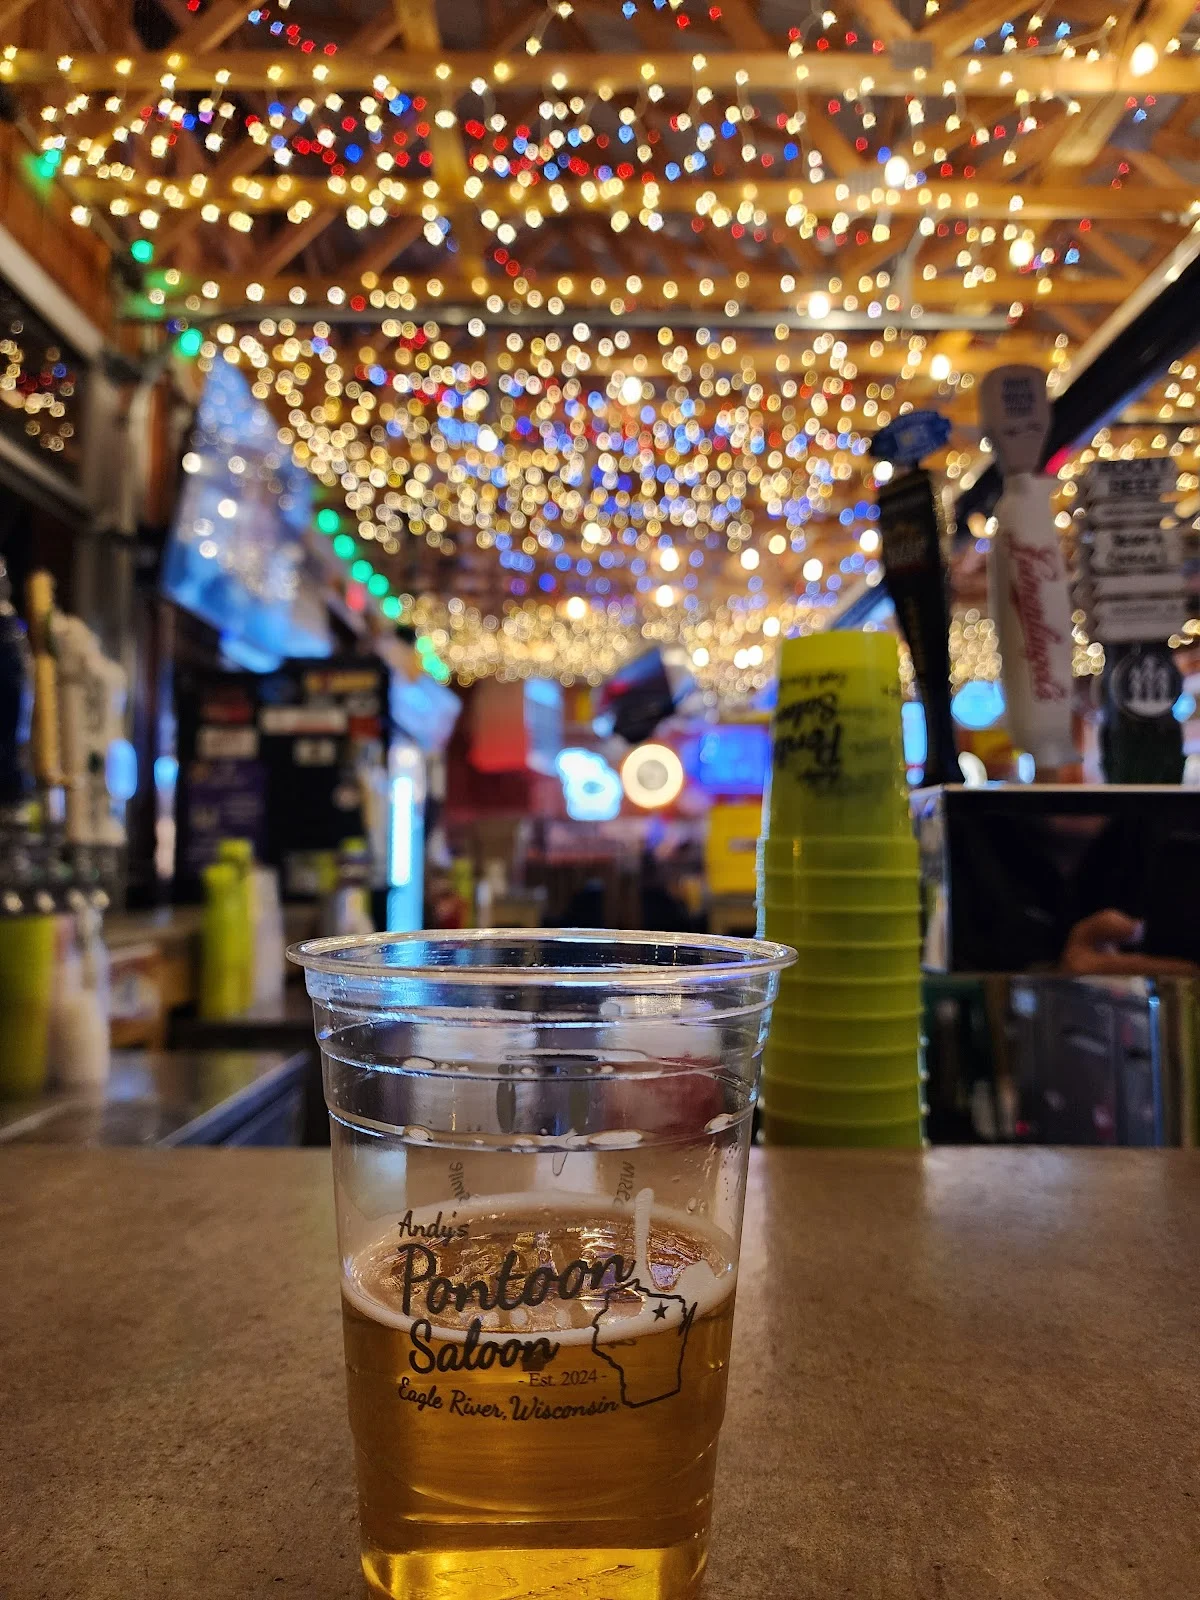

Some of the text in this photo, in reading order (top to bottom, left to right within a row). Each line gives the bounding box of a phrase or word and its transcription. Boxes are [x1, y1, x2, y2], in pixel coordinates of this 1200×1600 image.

[398, 1210, 470, 1247] Andy's
[398, 1243, 637, 1317] Pontoon
[409, 1318, 560, 1374] Saloon
[398, 1377, 619, 1421] Eagle River, Wisconsin
[561, 1369, 598, 1387] 2024
